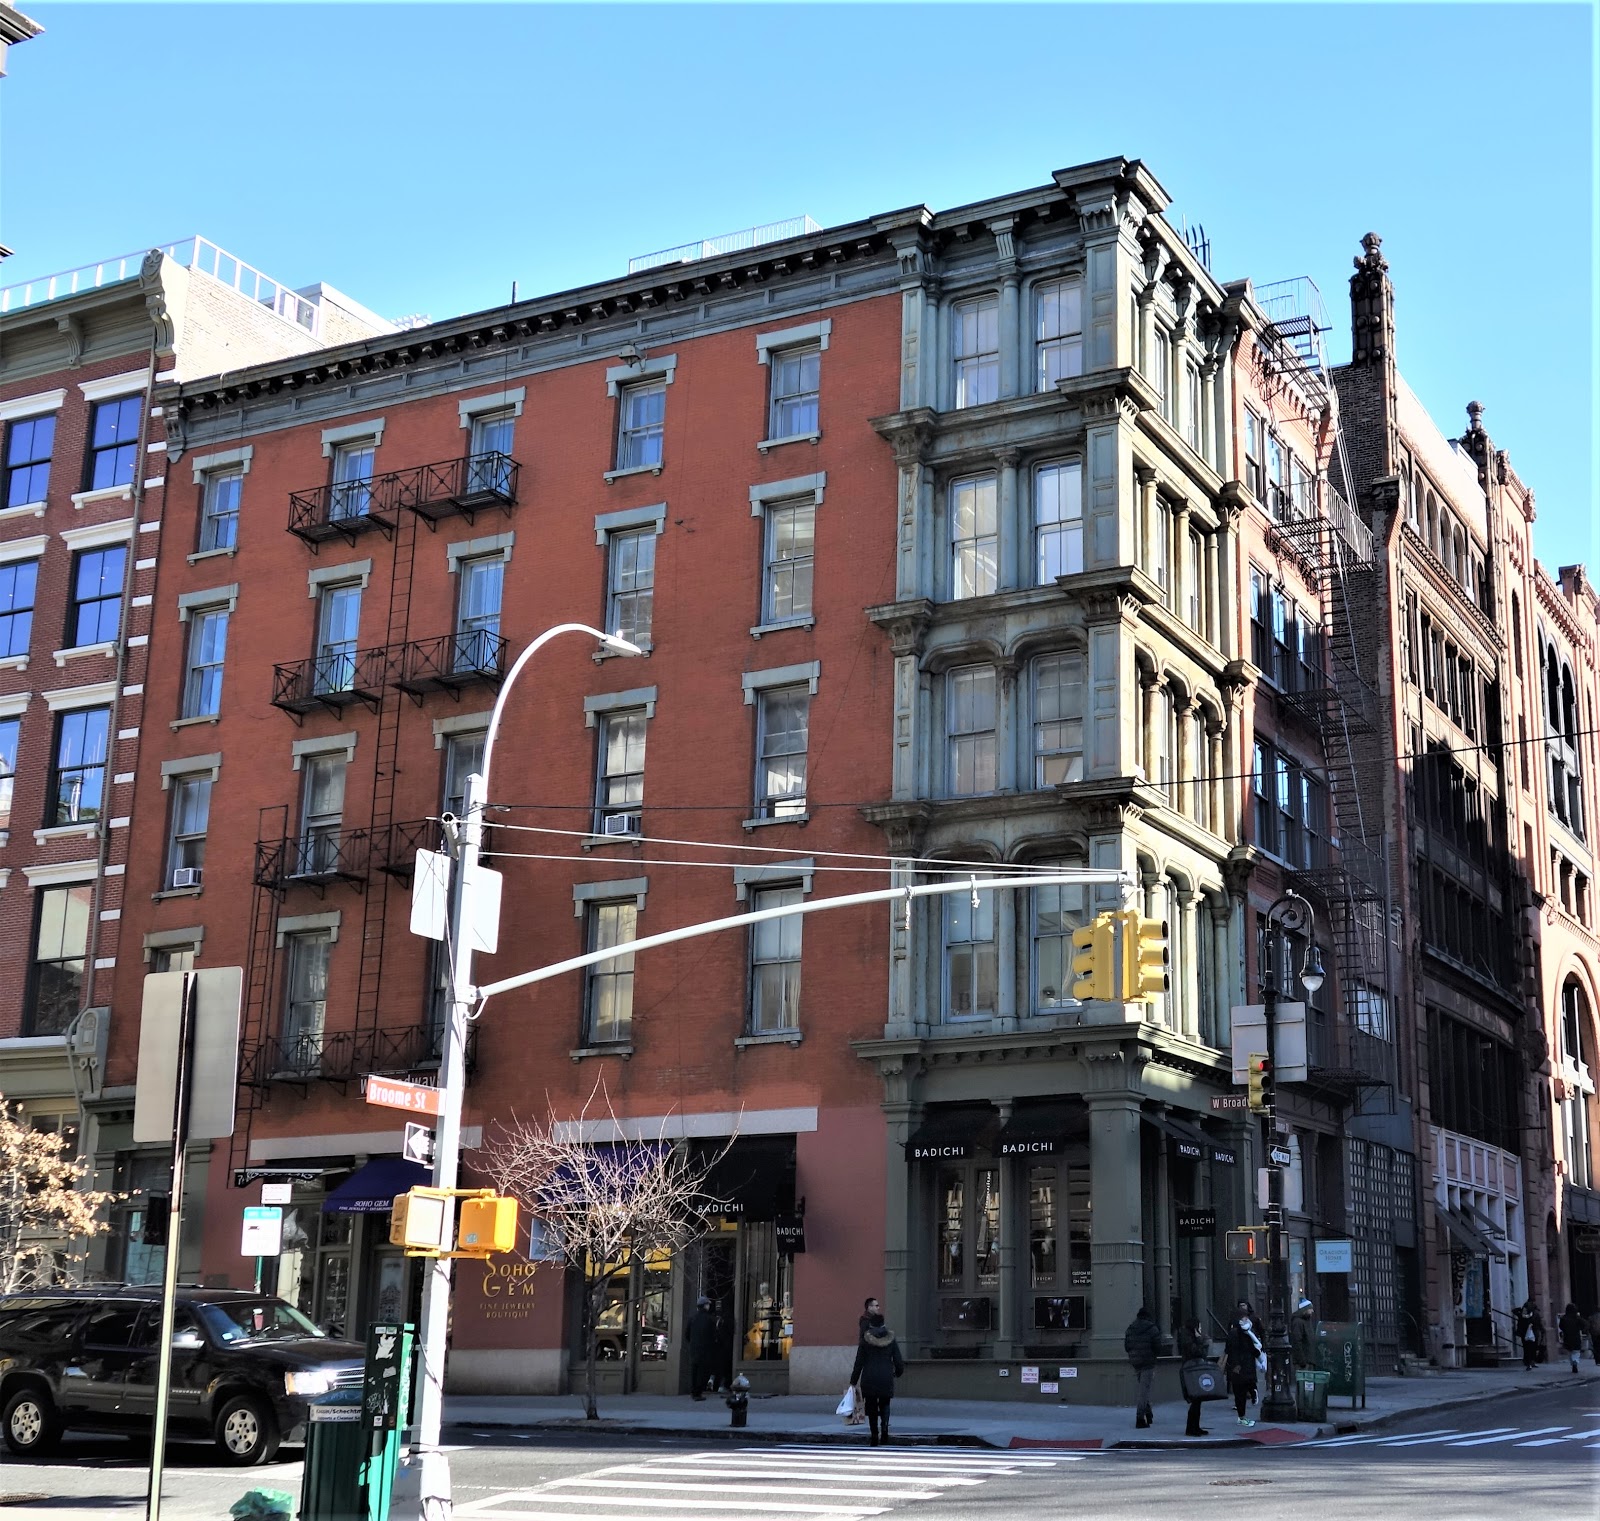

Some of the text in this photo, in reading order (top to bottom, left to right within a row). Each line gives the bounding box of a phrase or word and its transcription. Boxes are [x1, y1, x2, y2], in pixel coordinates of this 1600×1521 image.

[369, 1083, 426, 1109] Broome St
[1212, 1098, 1249, 1109] W Broad
[915, 1147, 964, 1157] BADICHI
[1002, 1142, 1053, 1153] BADICHI
[1180, 1144, 1201, 1156] BADICHI
[1215, 1151, 1235, 1164] BADICHI
[697, 1203, 744, 1213] BADICHI
[1179, 1217, 1215, 1225] BADICHI
[776, 1227, 804, 1236] BADICHI
[485, 1259, 536, 1277] SOHO
[483, 1274, 534, 1297] GEM
